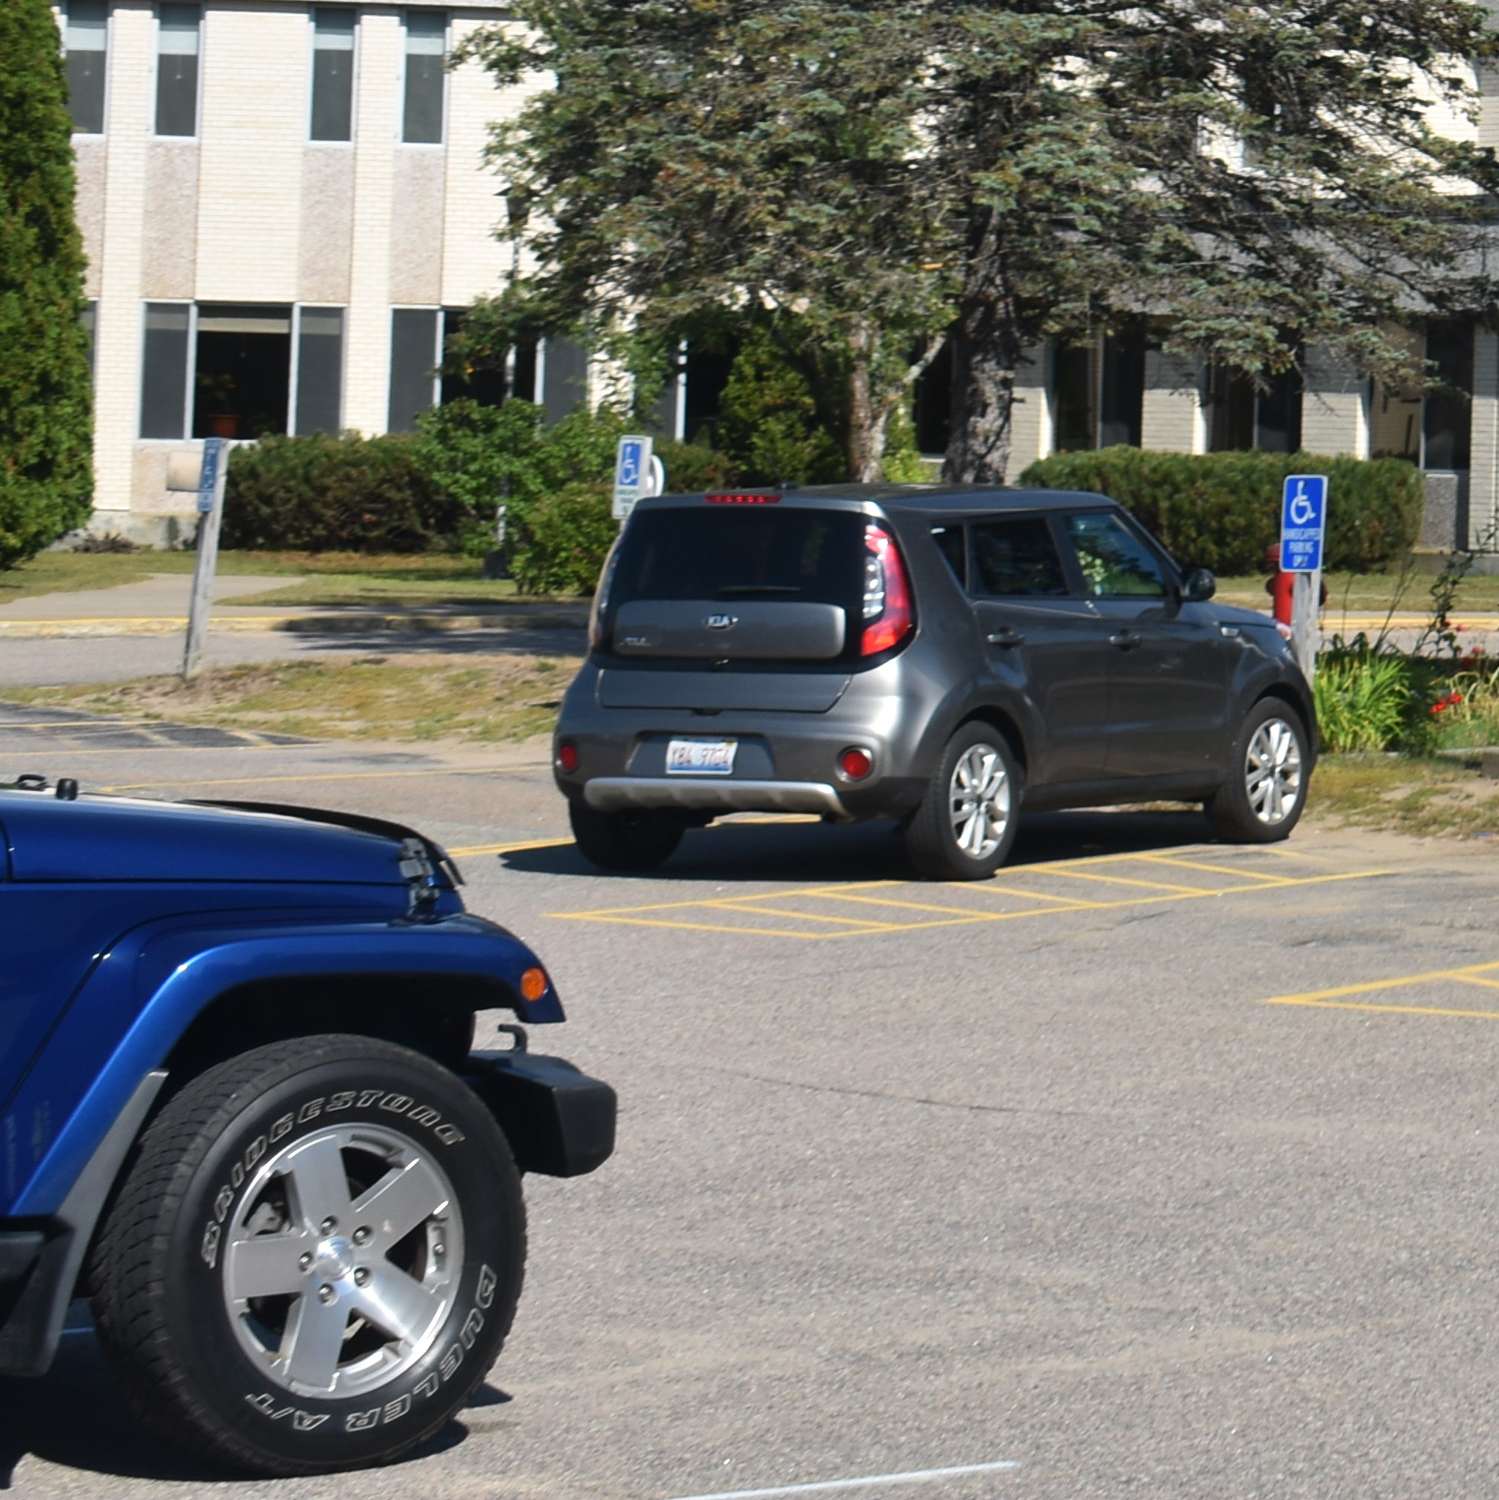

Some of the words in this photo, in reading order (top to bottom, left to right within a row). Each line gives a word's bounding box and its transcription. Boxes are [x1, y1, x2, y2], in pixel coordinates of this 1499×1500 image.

[708, 615, 730, 627] KIA
[201, 1089, 466, 1269] BRIDGESTONE
[345, 1264, 498, 1433] DUELER
[244, 1393, 332, 1431] A/T
